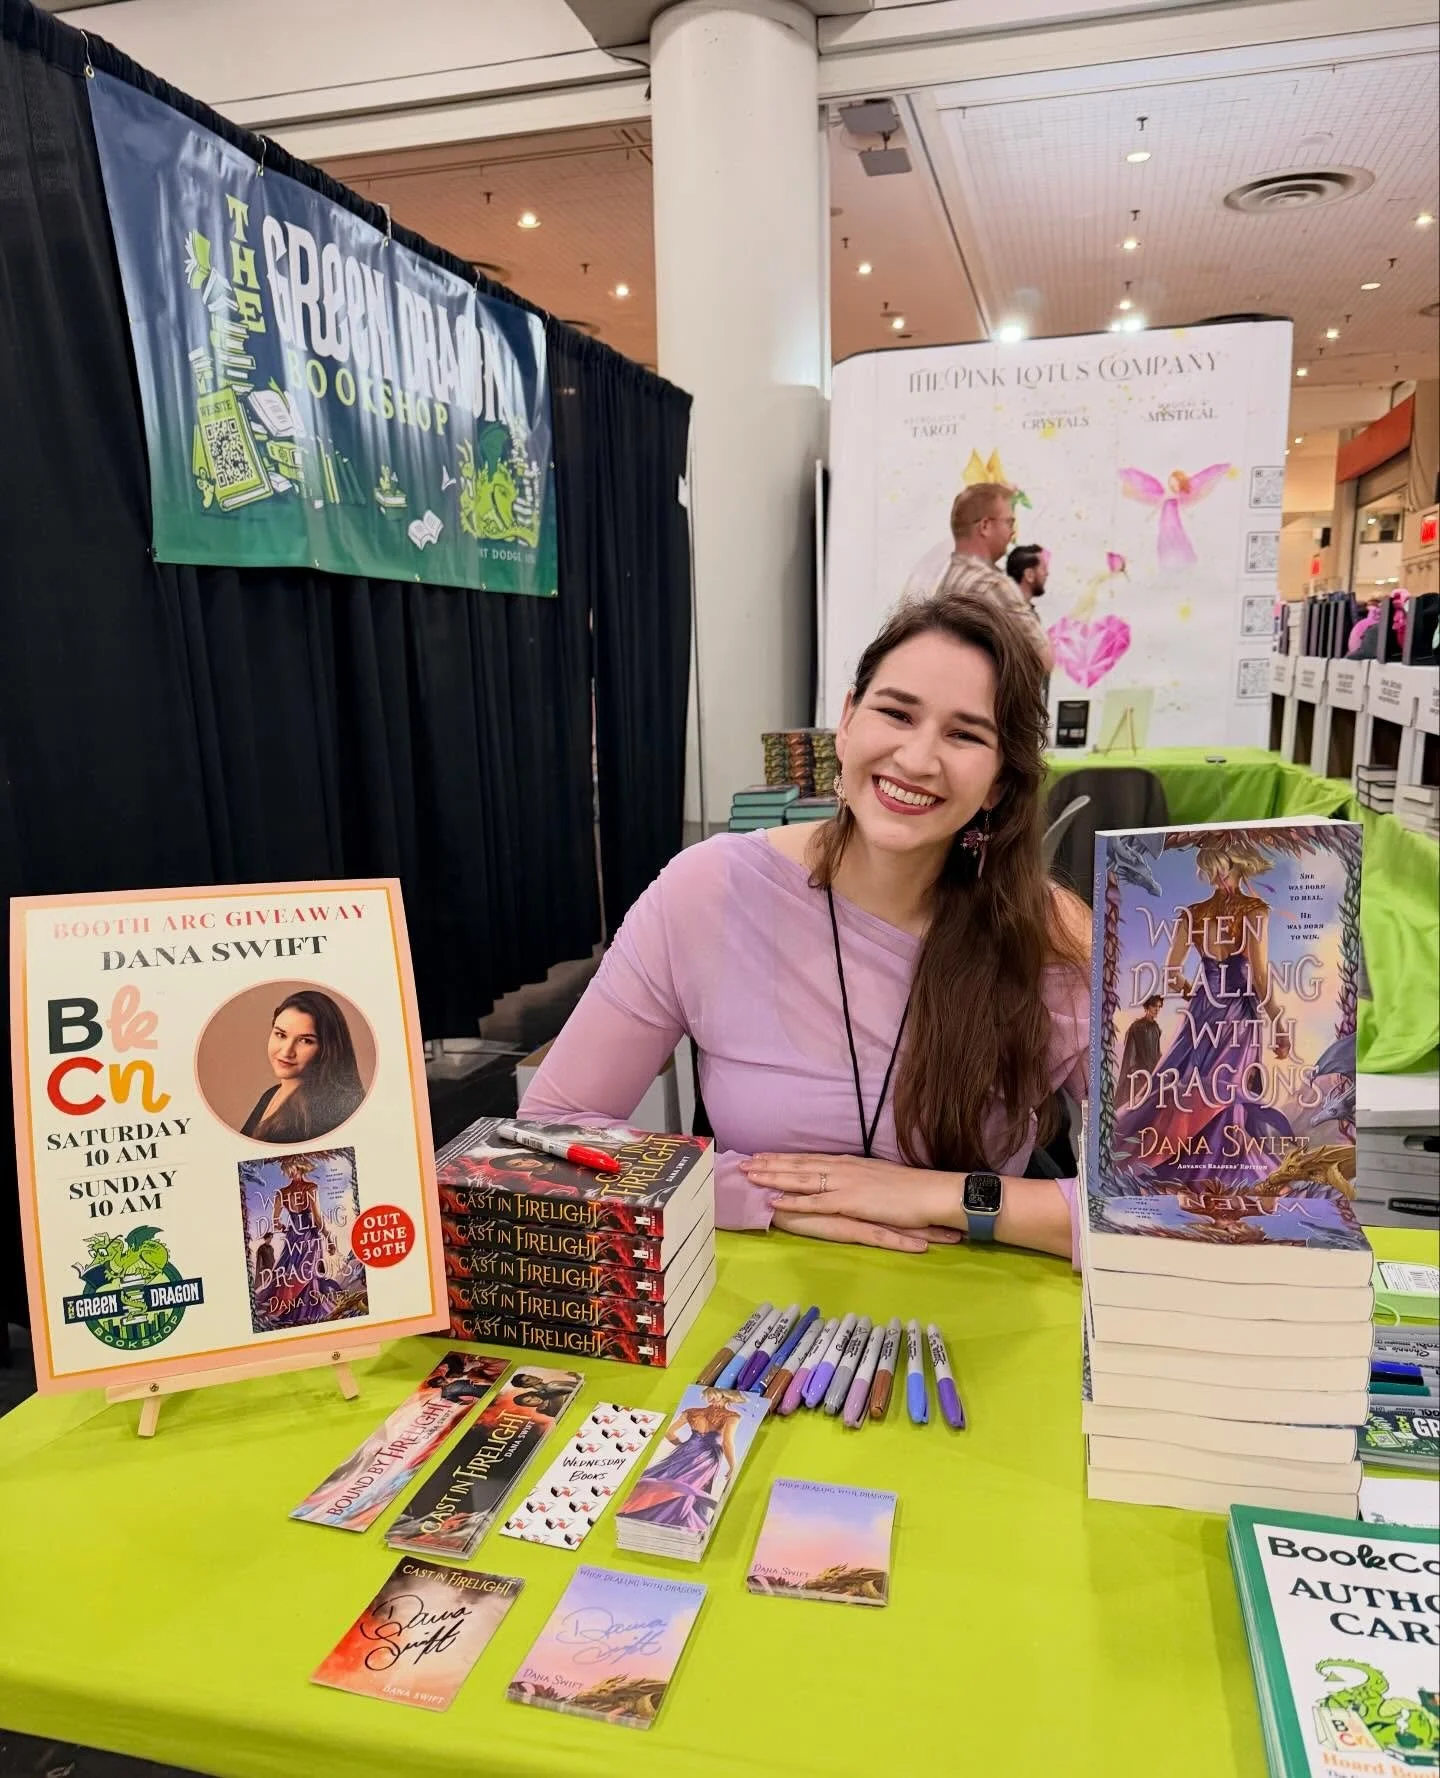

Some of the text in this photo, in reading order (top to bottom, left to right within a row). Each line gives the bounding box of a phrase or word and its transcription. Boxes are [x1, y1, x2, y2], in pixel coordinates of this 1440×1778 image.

[225, 193, 266, 333] THE
[909, 352, 1217, 393] THE PINK LOTUS COMPANY
[287, 350, 448, 435] BOOKSHOP
[912, 423, 959, 438] TAROT
[1022, 416, 1089, 431] CRYSTALS
[1147, 408, 1218, 422] MYSTICAL
[53, 904, 368, 940] BOOTH ARC GIVEAWAY
[1135, 905, 1266, 959] WHEN
[100, 935, 328, 971] DANA SWIFT
[1130, 954, 1325, 1010] DEALING
[1176, 1006, 1304, 1064] WITH
[1126, 1062, 1323, 1113] DRAGONS
[47, 1118, 192, 1151] SATURDAY
[84, 1143, 159, 1167] 10 AM
[600, 1134, 691, 1197] FIRELIGHT
[69, 1170, 177, 1201] SUNDAY
[254, 1189, 317, 1213] WHEN
[88, 1193, 163, 1218] 10 AM
[255, 1205, 348, 1240] DEALING
[363, 1212, 401, 1229] OUT
[455, 1192, 601, 1228] CAST IN FIRELIGHT
[281, 1233, 341, 1258] WITH
[360, 1226, 407, 1245] JUNE
[362, 1241, 407, 1261] 30TH
[456, 1225, 600, 1261] CAST IN FIRELIGHT
[259, 1257, 353, 1290] DRAGONS
[459, 1257, 604, 1293] CAST IN FIRELIGHT
[150, 1283, 200, 1307] DRAGON
[459, 1289, 603, 1326] CAST IN FIRELIGHT
[94, 1315, 179, 1349] BOOKSHOP
[462, 1319, 605, 1356] CAST IN FIRELIGHT
[504, 1420, 535, 1458] DANA SWIFT
[327, 1399, 451, 1516] BOUND BY FIRELIGHT
[421, 1409, 532, 1533] CAST IN FIRELIGHT
[562, 1456, 626, 1470] WEDNESDAY
[569, 1470, 609, 1482] BOOKS
[402, 1564, 516, 1596] CAST IN FIRELIGHT
[1330, 1612, 1439, 1646] CAR
